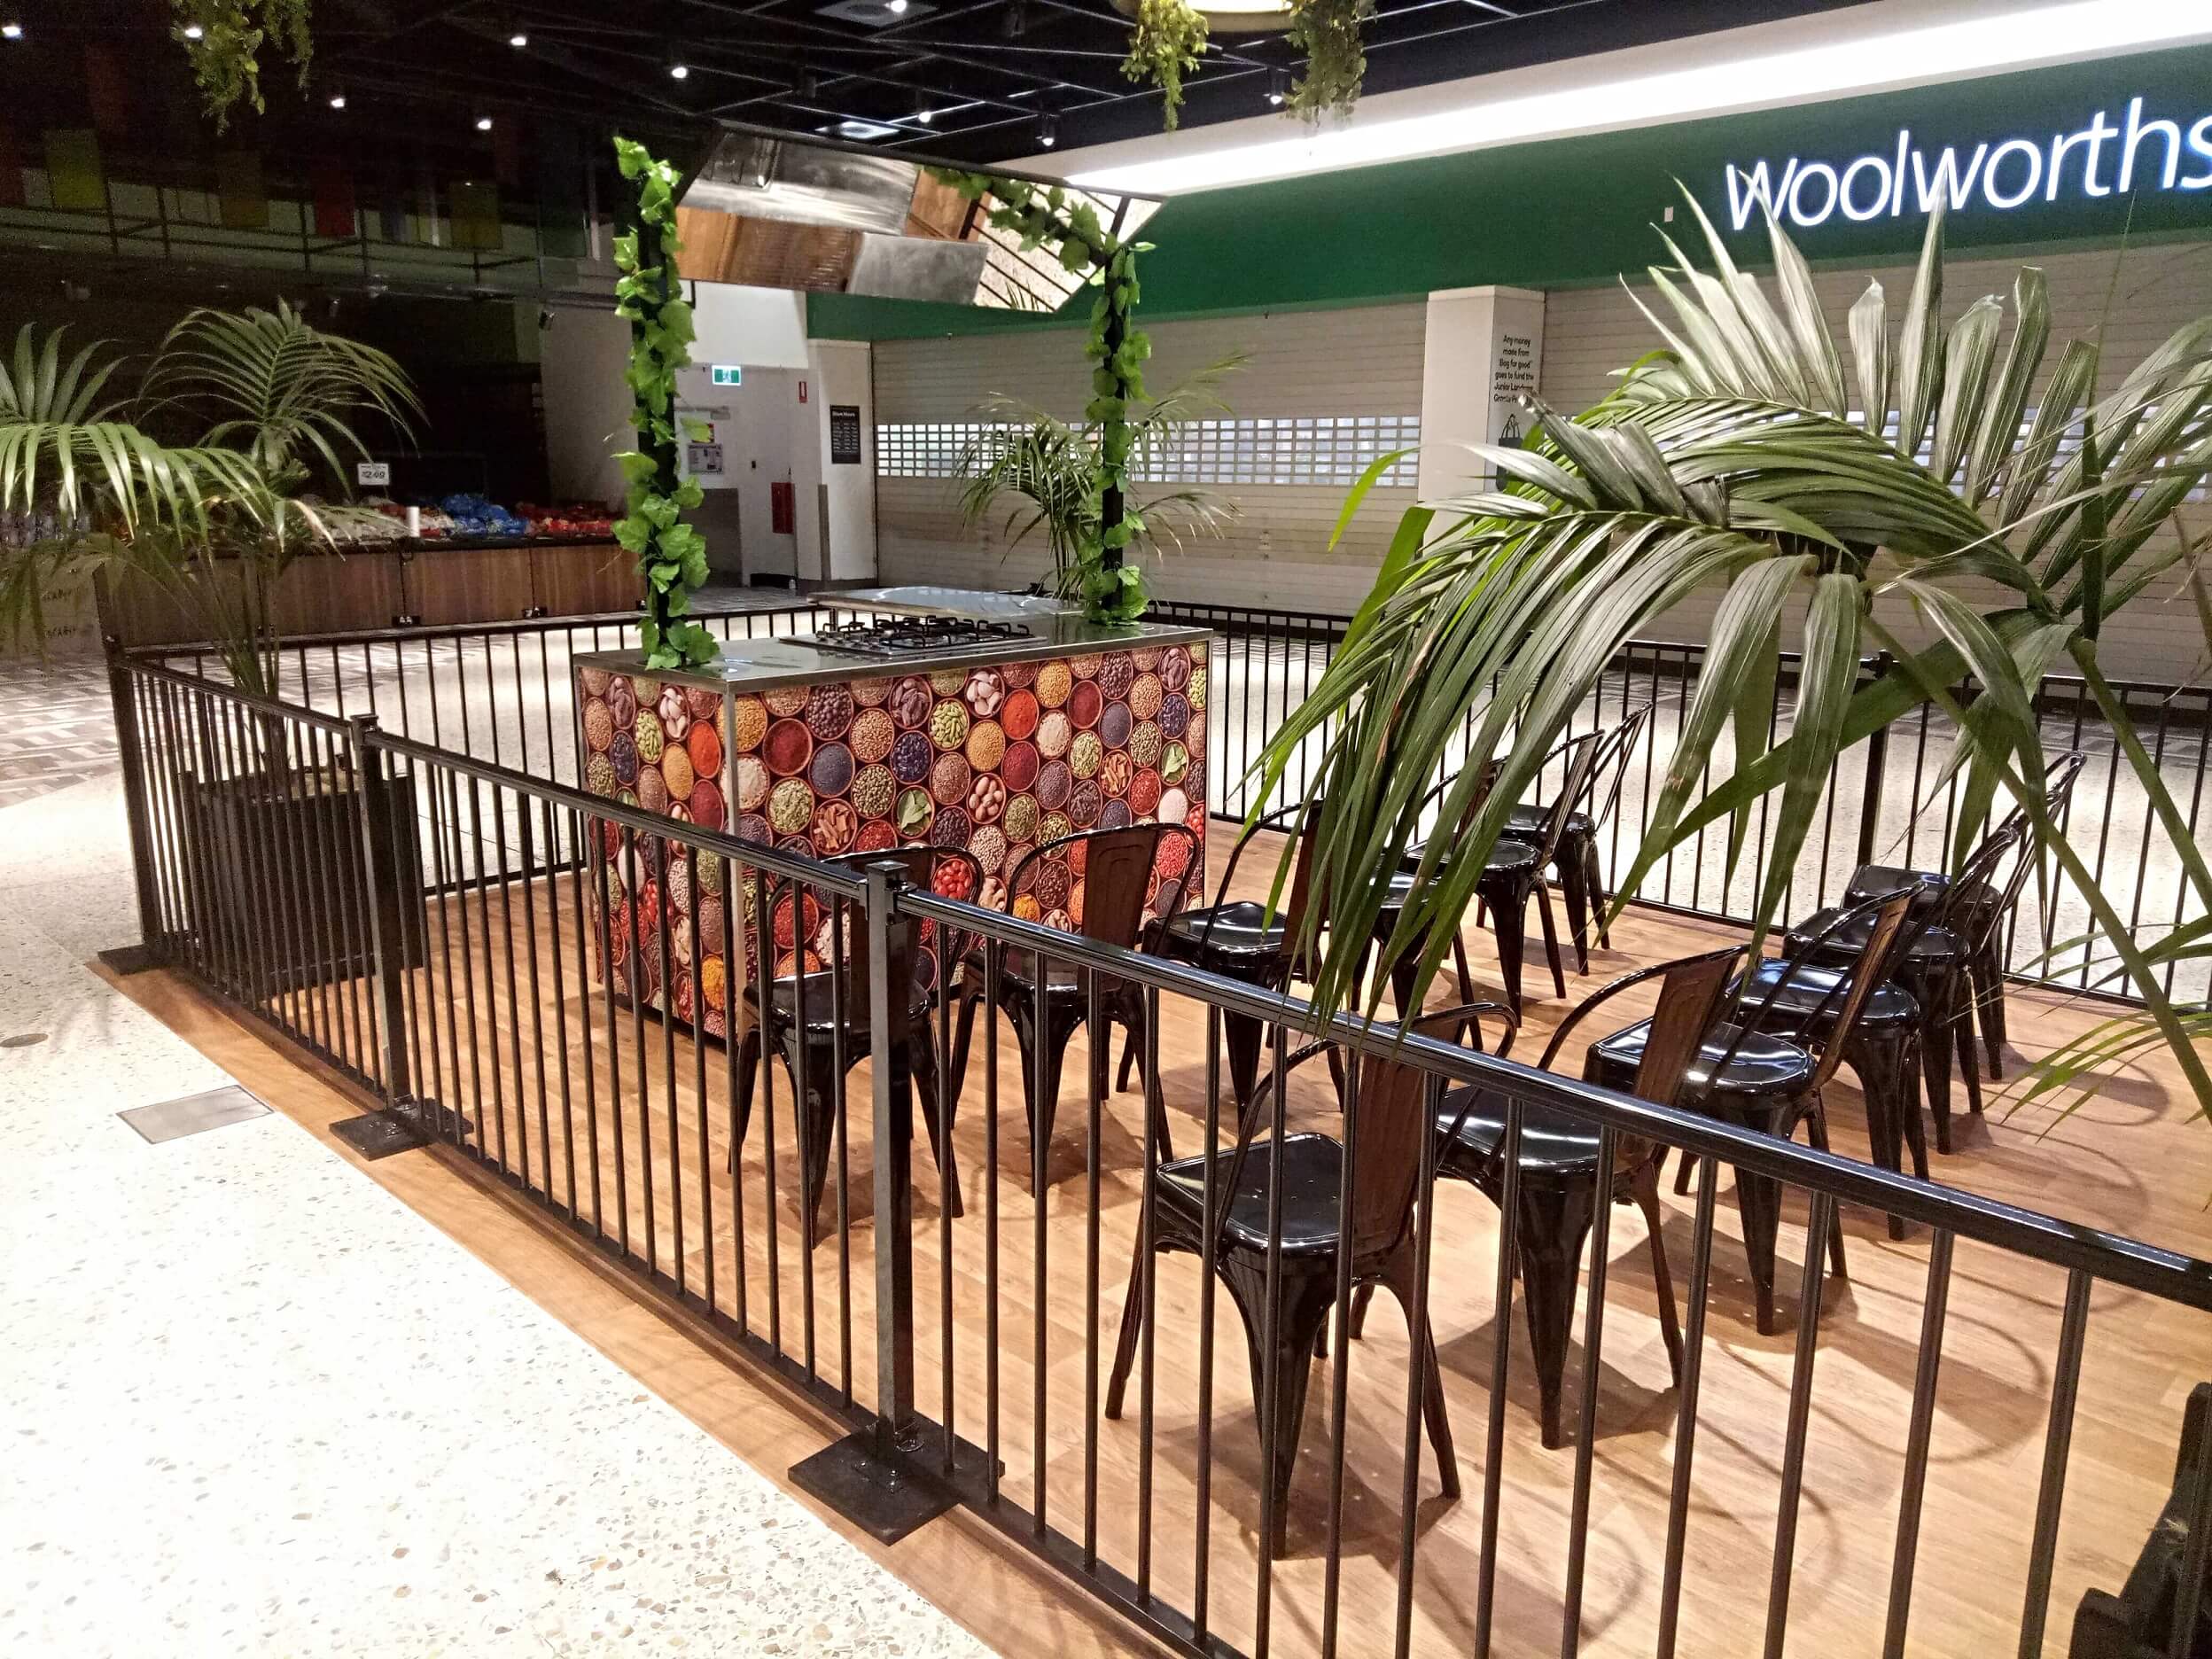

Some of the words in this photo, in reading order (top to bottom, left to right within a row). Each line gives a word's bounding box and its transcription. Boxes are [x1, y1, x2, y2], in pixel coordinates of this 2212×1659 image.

[1503, 335, 1513, 347] Any
[1514, 339, 1531, 347] money
[1515, 371, 1525, 380] fund
